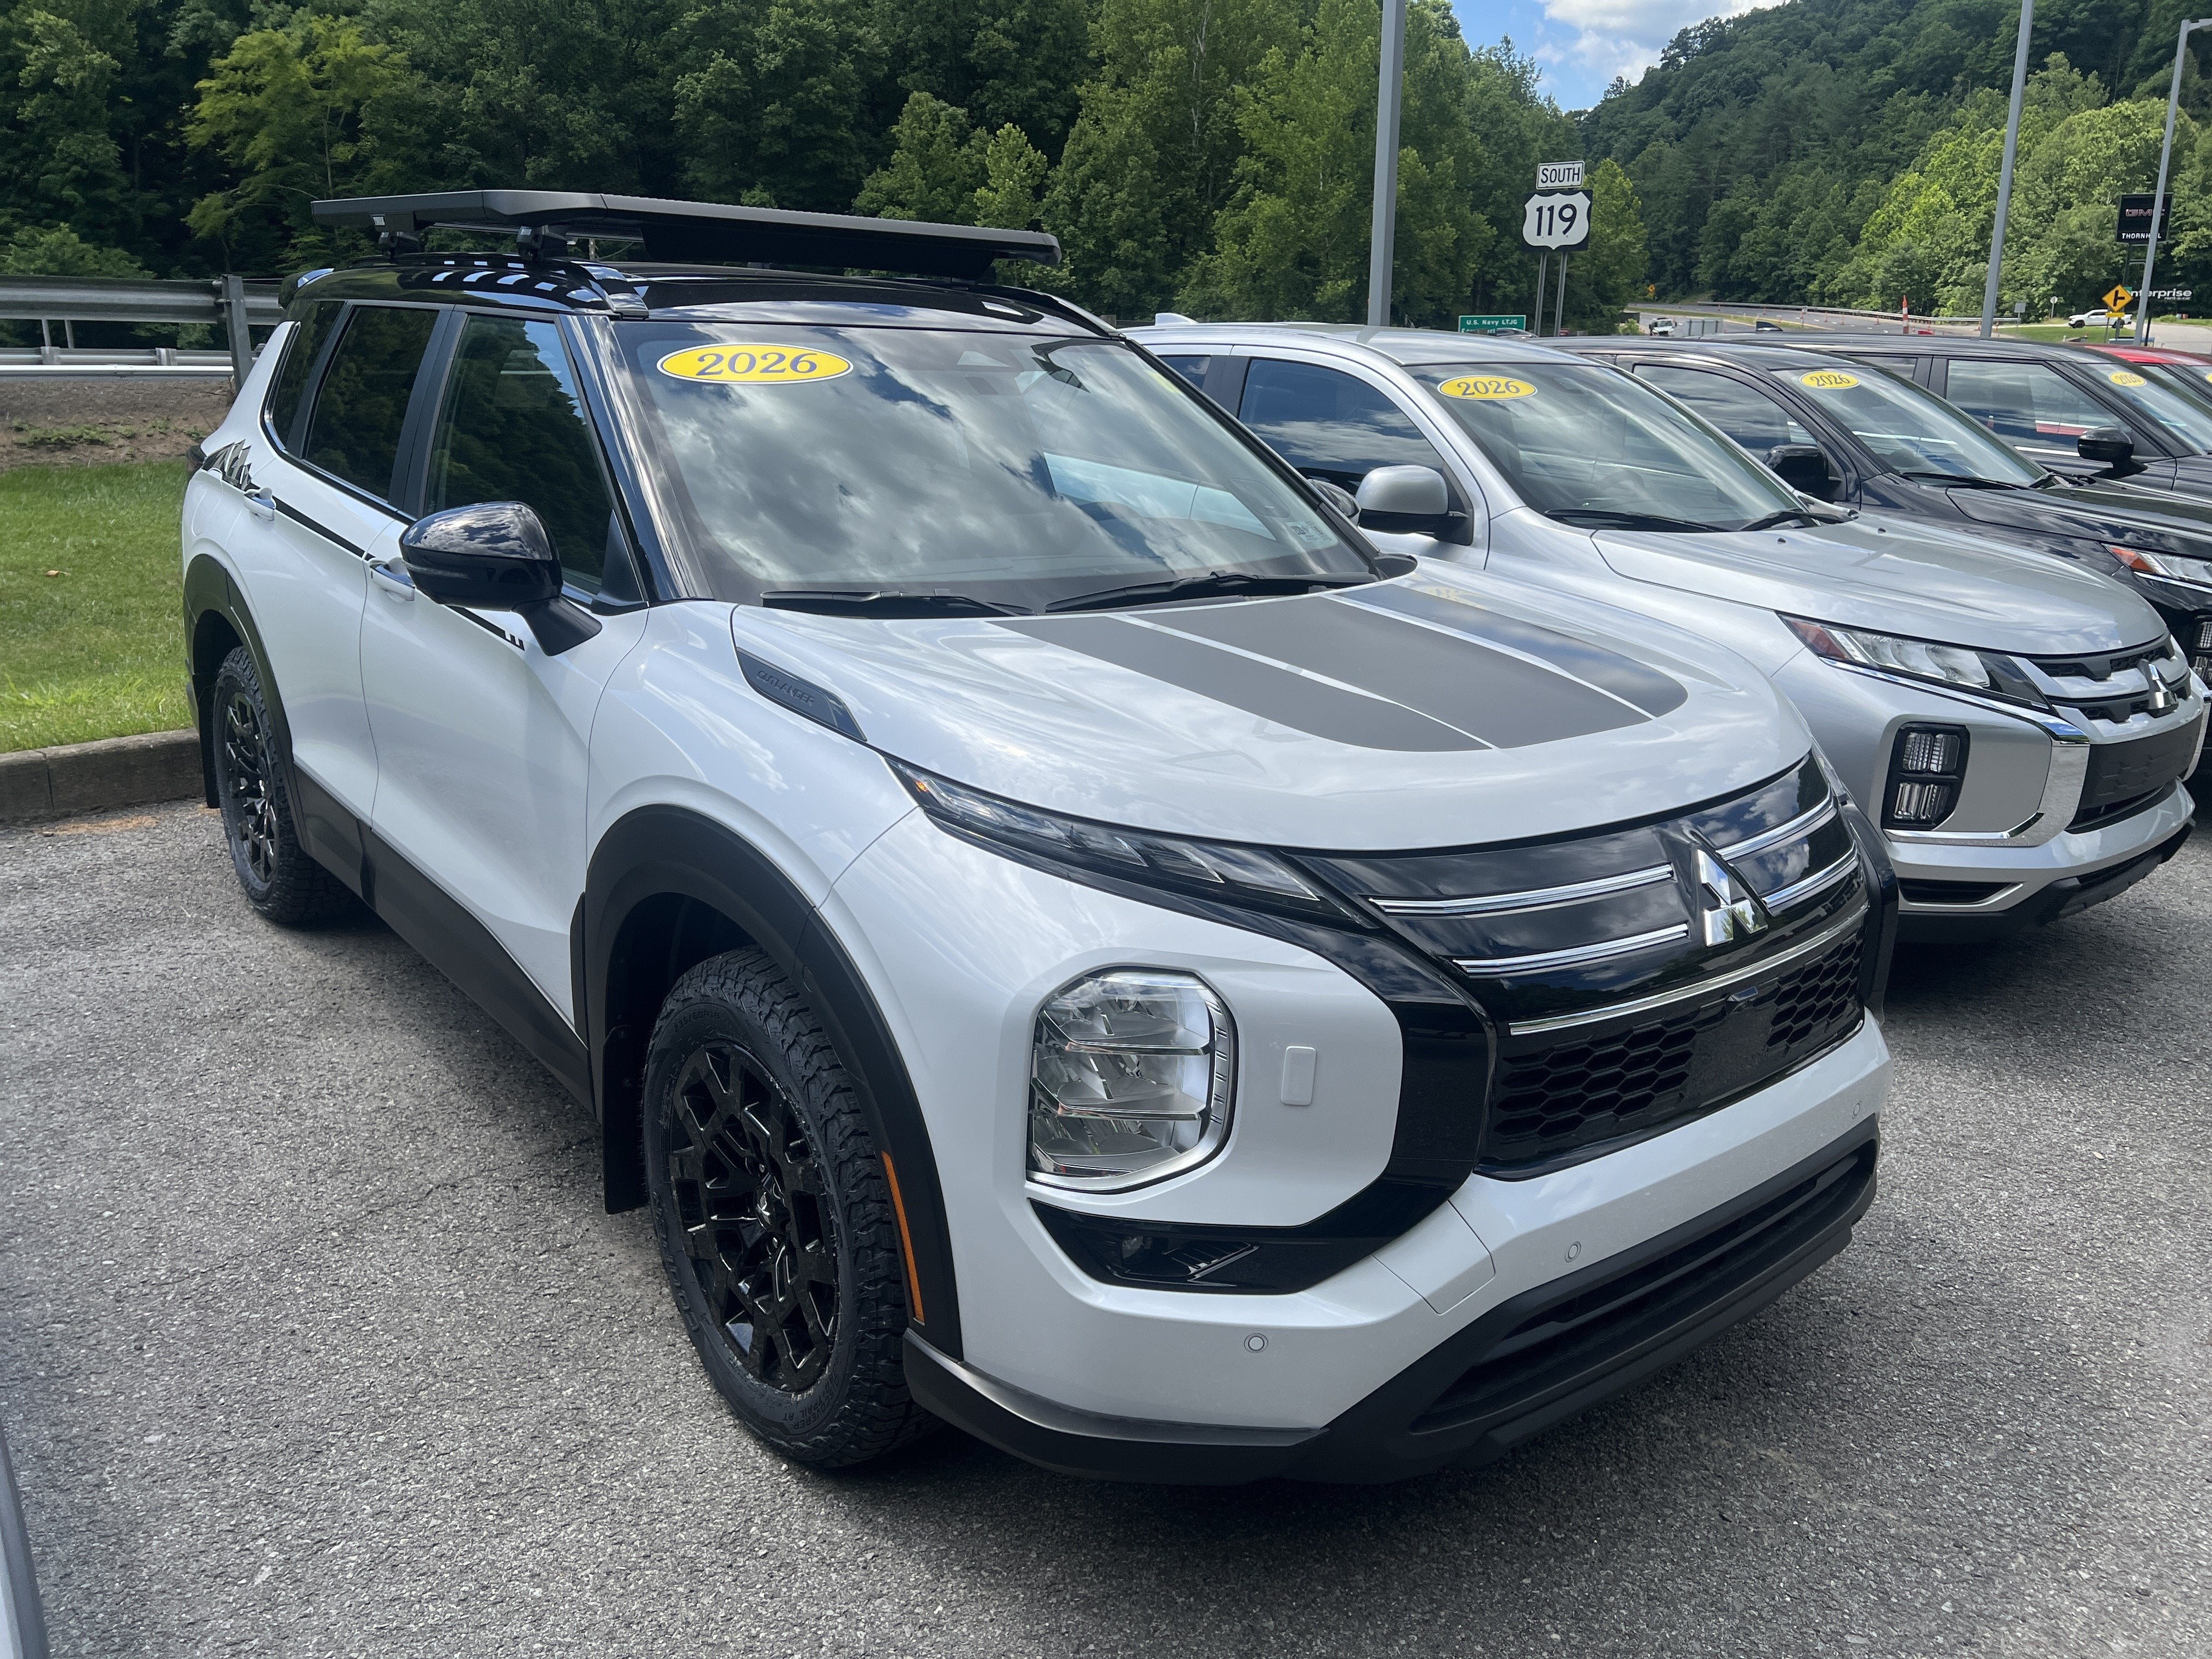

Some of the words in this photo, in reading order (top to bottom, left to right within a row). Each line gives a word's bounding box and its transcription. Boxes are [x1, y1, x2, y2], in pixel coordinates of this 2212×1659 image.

[1541, 167, 1581, 184] SOUTH
[1536, 203, 1577, 236] 119
[2126, 288, 2192, 299] ntrprise
[696, 352, 817, 376] 2026
[1457, 380, 1520, 396] 2026
[1810, 374, 1850, 387] 2026
[756, 670, 815, 707] OUTLANDER
